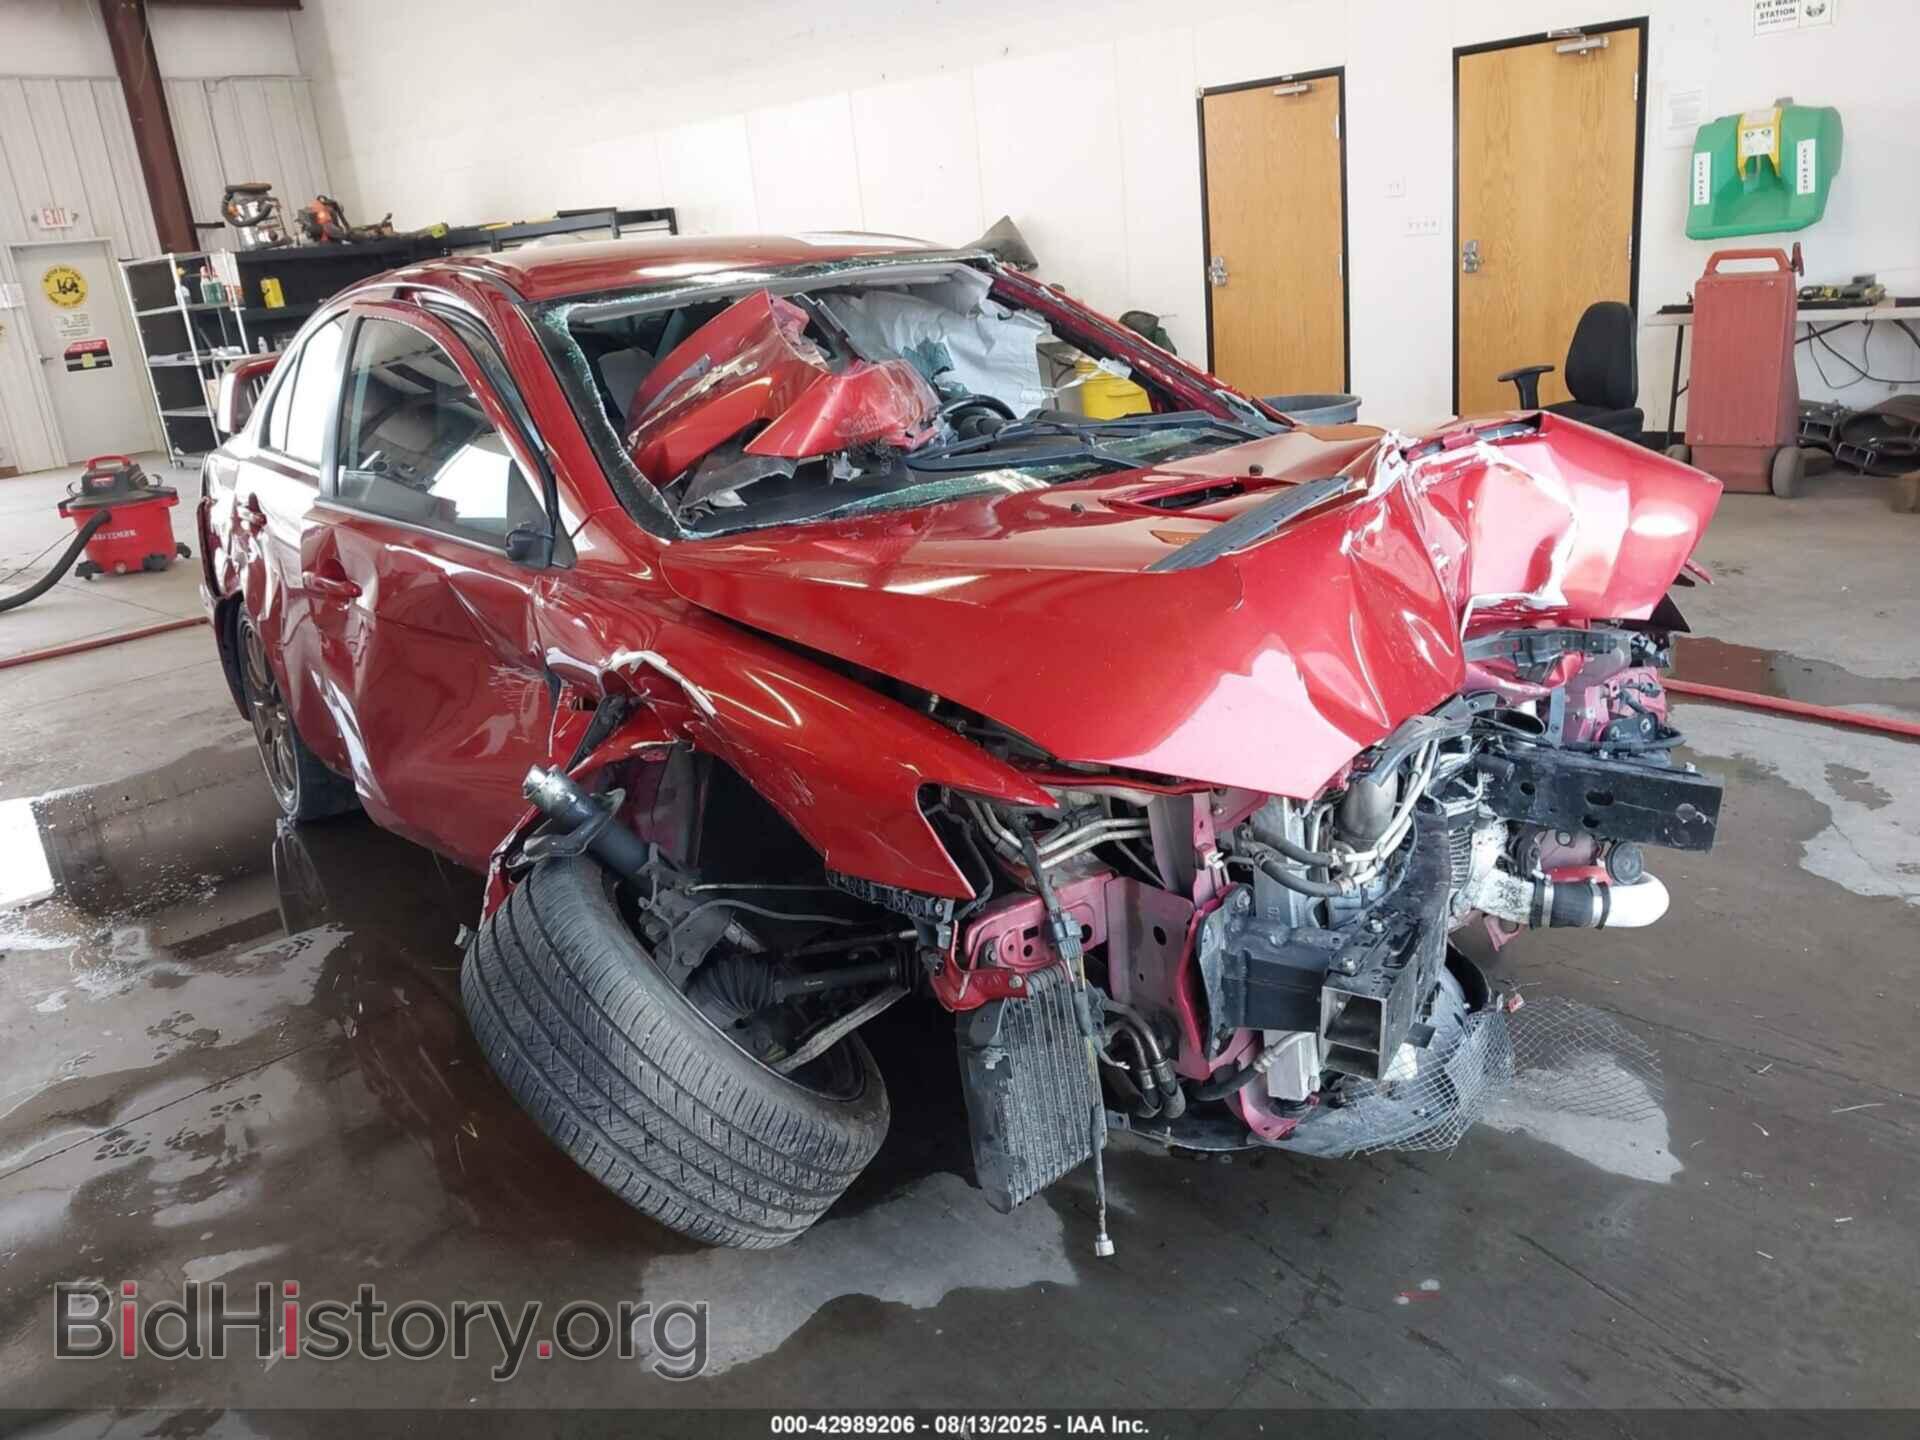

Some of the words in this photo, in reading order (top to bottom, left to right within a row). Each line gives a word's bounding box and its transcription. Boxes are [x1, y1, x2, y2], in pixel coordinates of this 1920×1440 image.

[1756, 1, 1772, 9] EYE
[1759, 7, 1795, 19] STATION
[43, 208, 66, 225] EXIT
